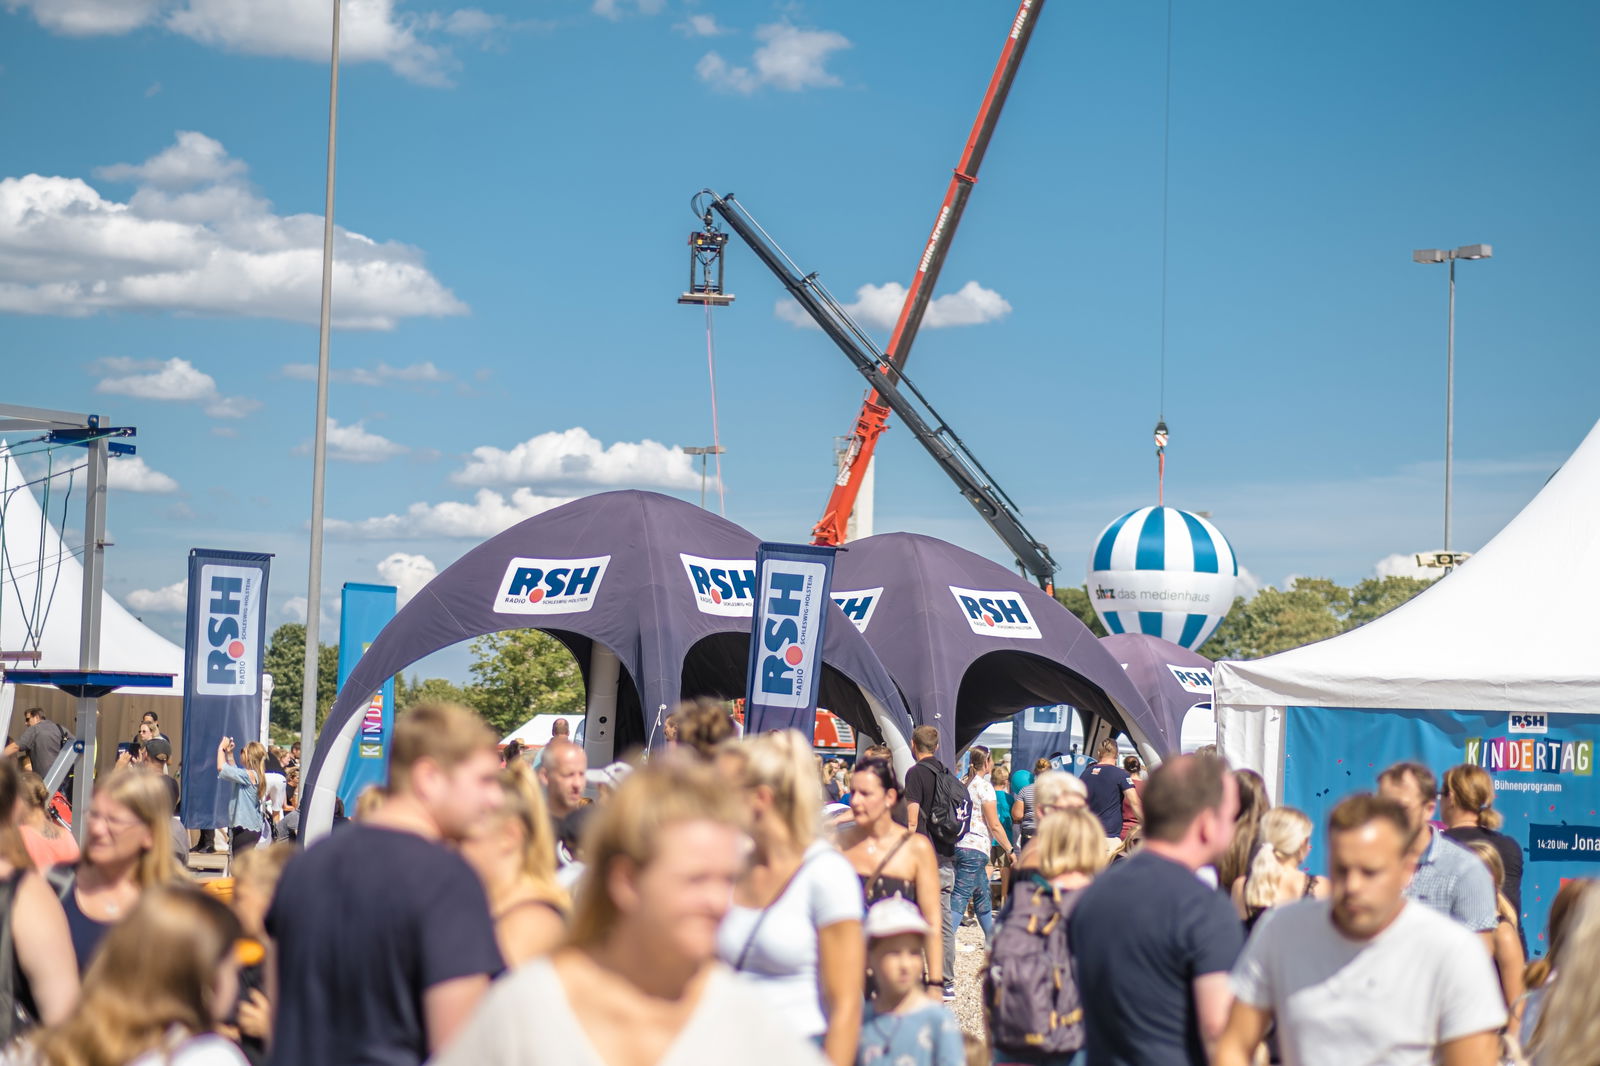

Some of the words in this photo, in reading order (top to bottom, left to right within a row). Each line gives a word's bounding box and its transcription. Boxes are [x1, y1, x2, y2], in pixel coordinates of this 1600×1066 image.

[1118, 587, 1136, 600] das
[1140, 589, 1210, 602] medienhaus
[796, 668, 804, 696] RADIO
[1467, 741, 1589, 771] KINDERTAG
[1494, 780, 1562, 793] Bühnenprogramm
[1537, 839, 1556, 849] 14:20
[1556, 840, 1569, 850] Uhr
